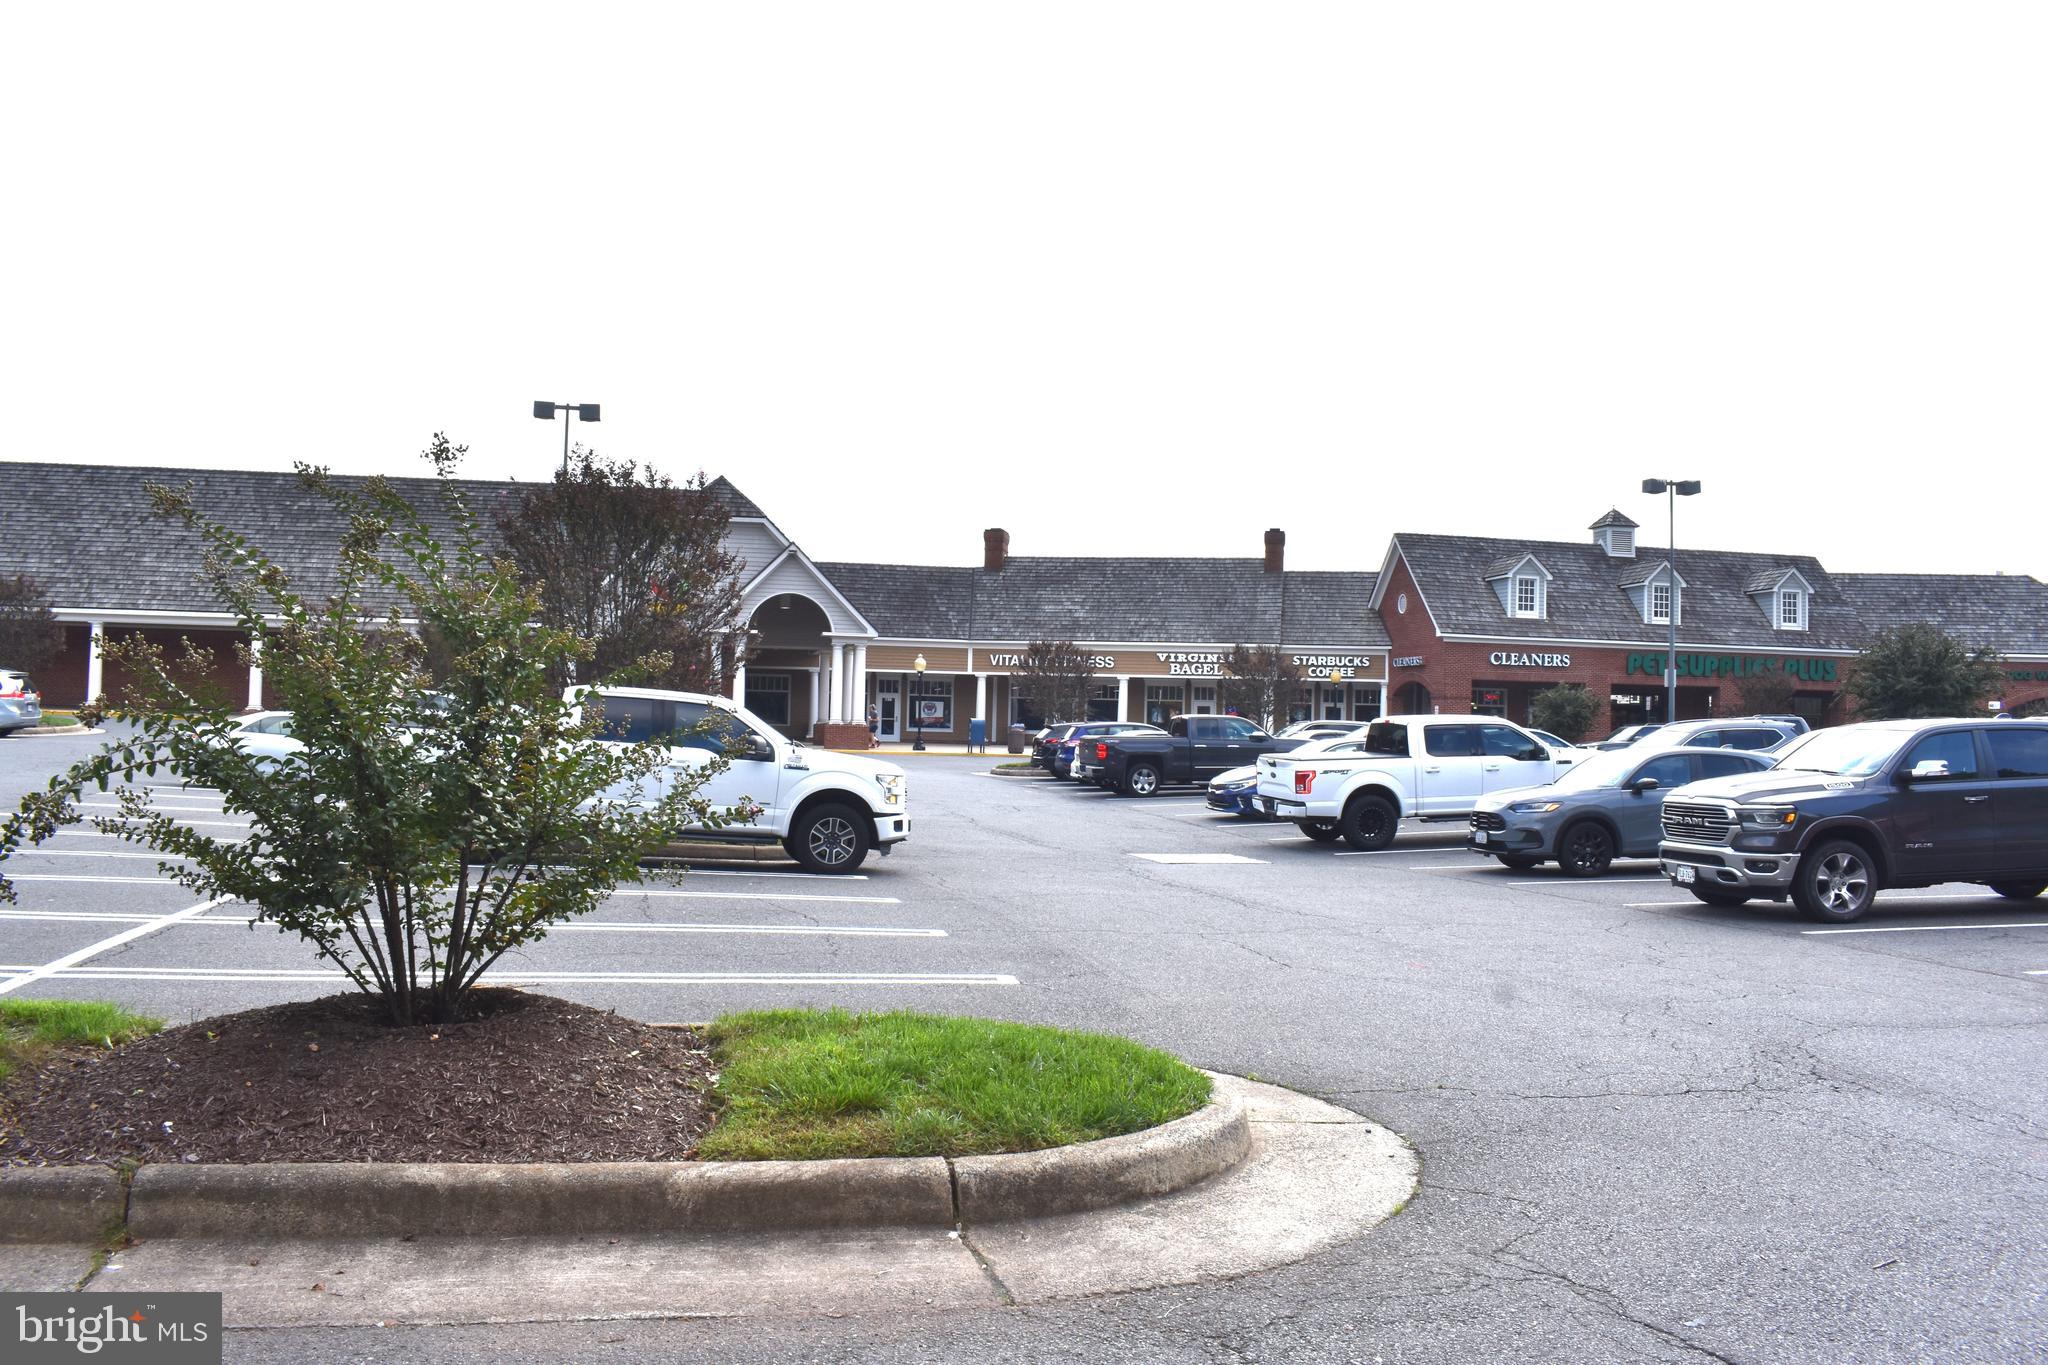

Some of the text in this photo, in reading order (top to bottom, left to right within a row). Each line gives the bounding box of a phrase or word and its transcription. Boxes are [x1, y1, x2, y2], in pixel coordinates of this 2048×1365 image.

[1292, 655, 1370, 667] STARBUCKS
[1489, 651, 1571, 667] CLEANERS
[1169, 663, 1224, 675] BAGEL
[1307, 666, 1356, 677] COFEE
[1627, 653, 1837, 681] PET SUPPLIES PLUS
[1672, 816, 1703, 825] RAM
